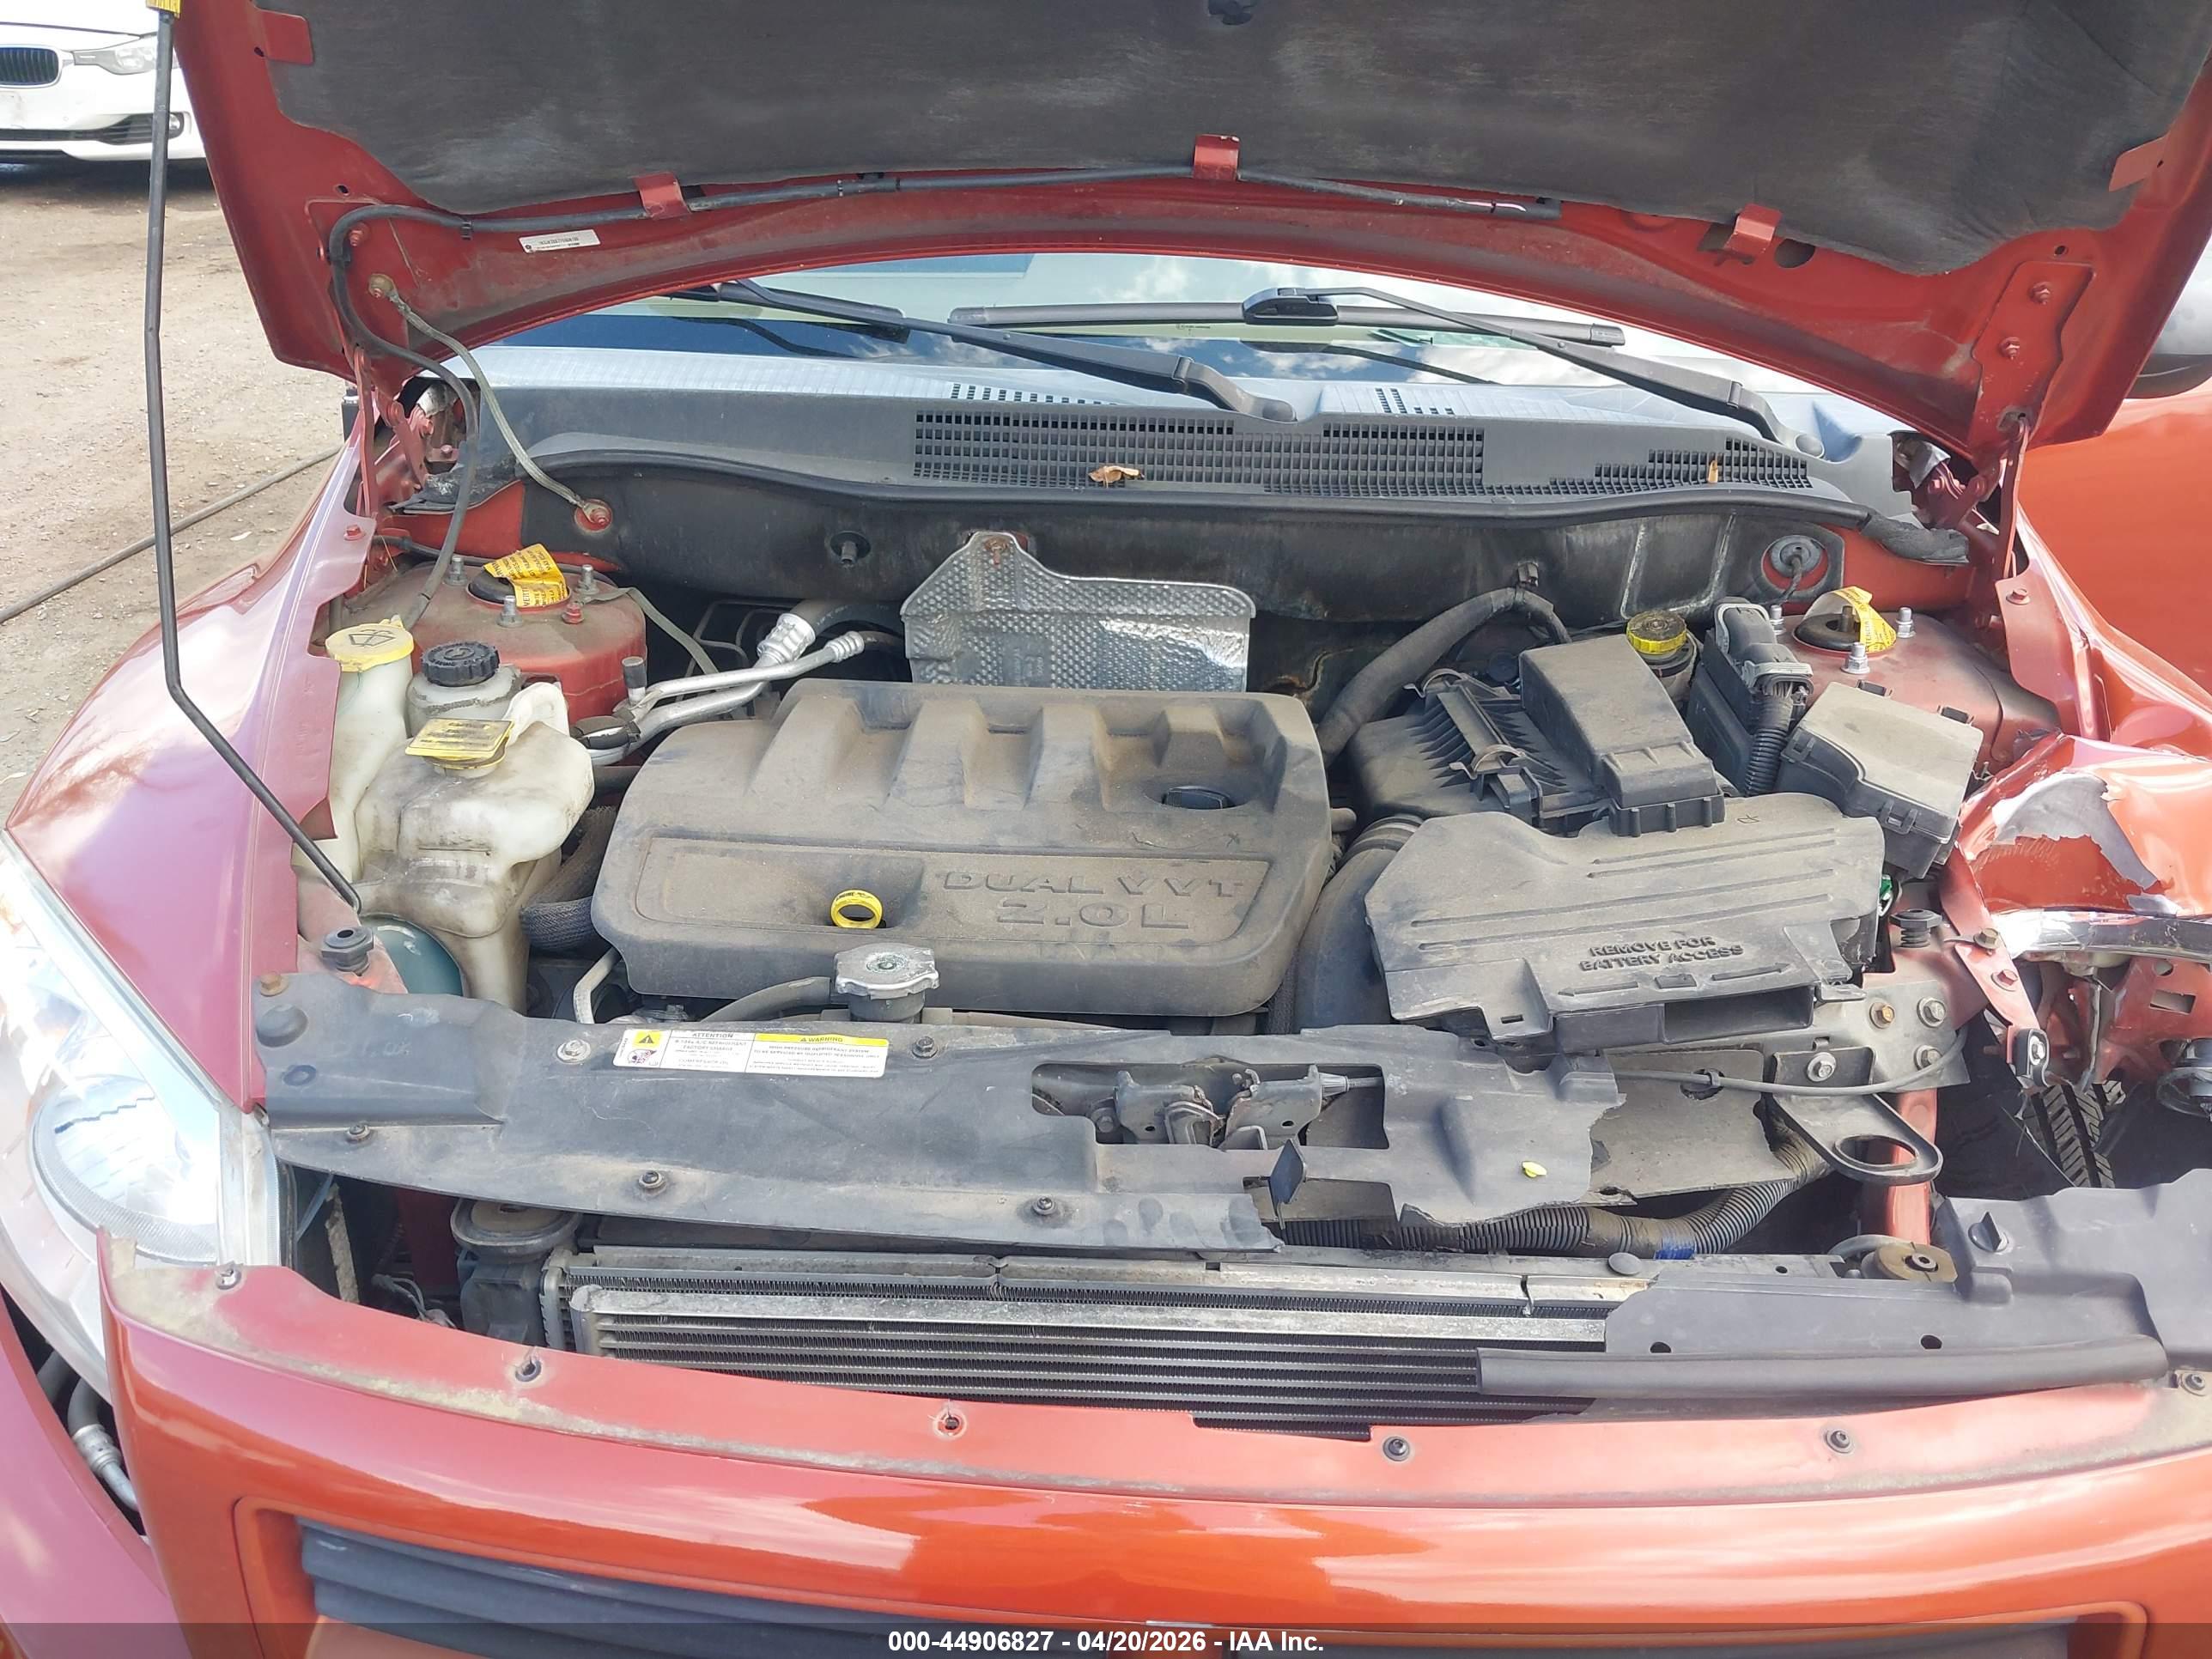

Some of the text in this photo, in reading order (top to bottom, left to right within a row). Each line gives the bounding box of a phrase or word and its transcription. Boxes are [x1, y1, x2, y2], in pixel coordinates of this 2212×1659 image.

[943, 871, 1244, 898] DUAL VVT
[991, 896, 1190, 930] 2.0L
[1578, 945, 1745, 972] BATTERY ACCESS
[1589, 936, 1717, 957] REMOVE FOR
